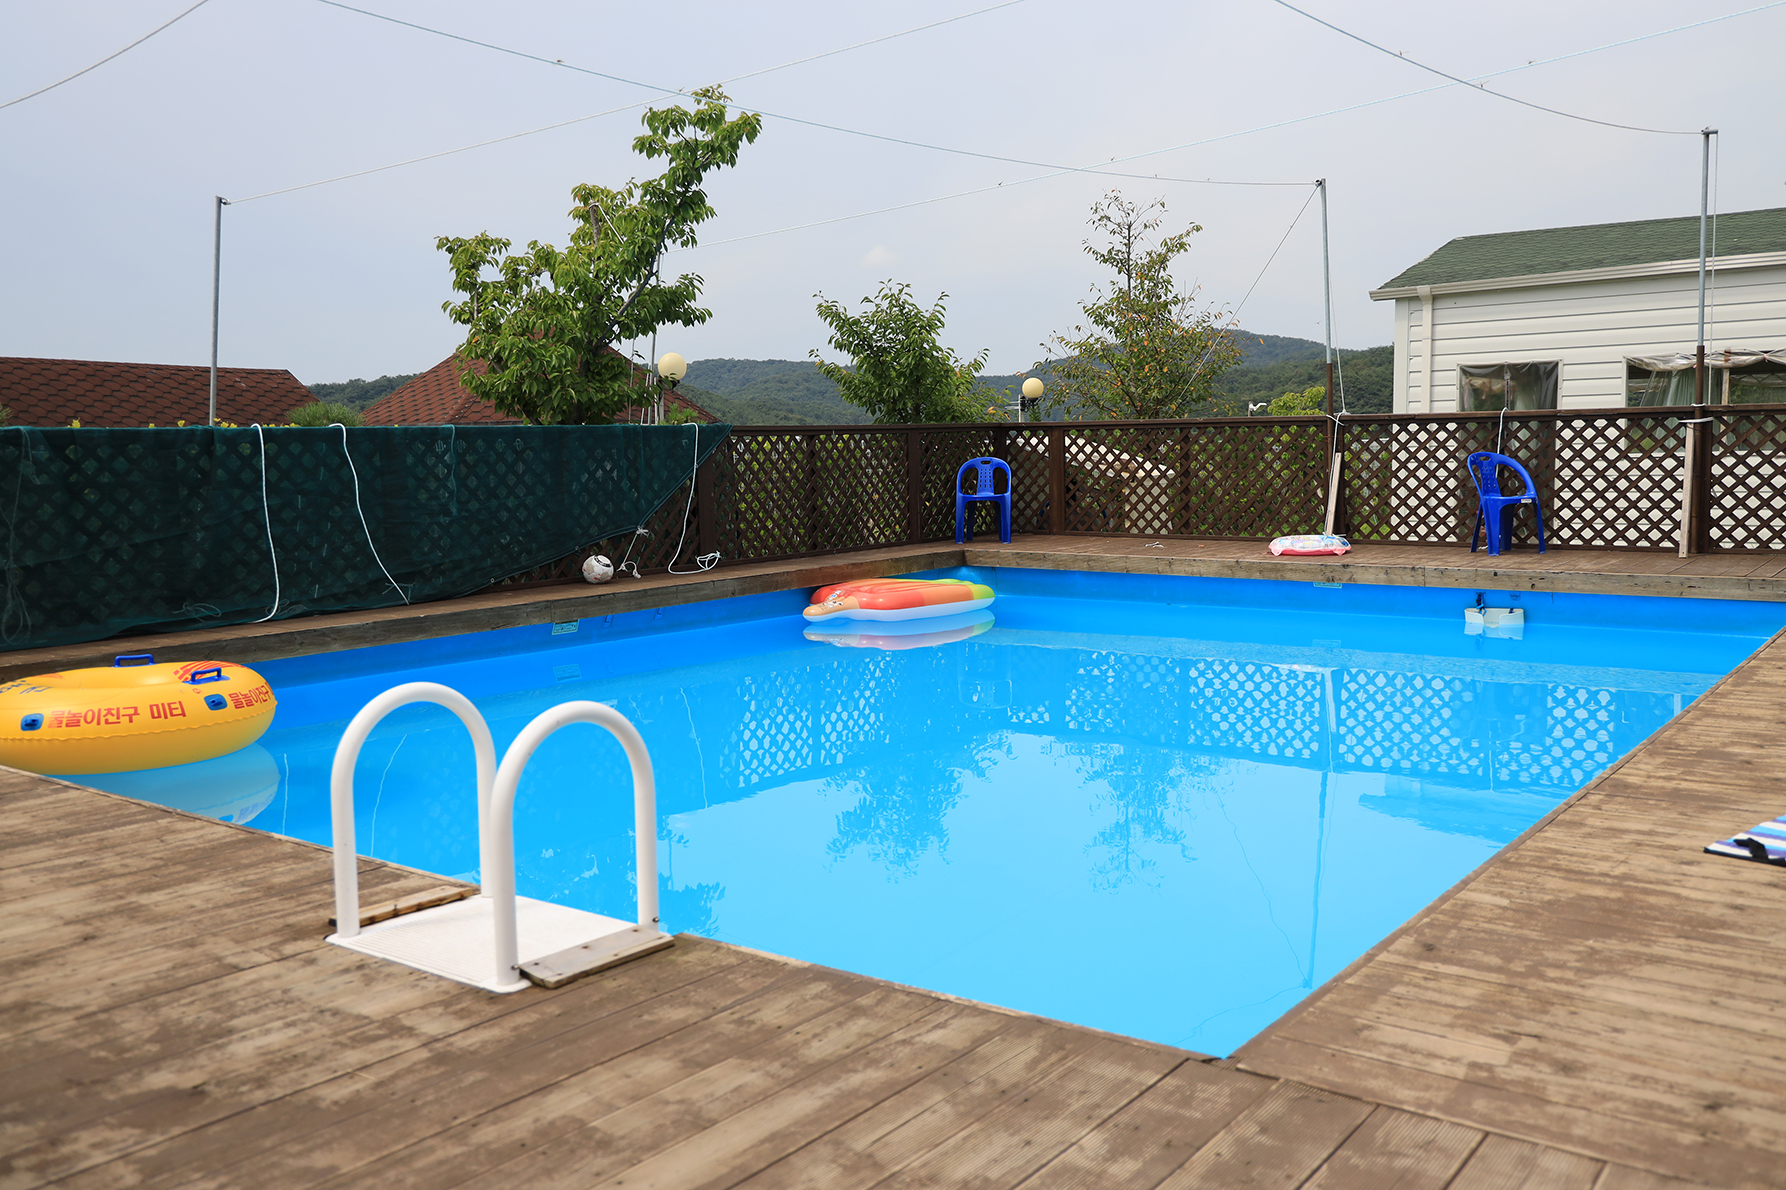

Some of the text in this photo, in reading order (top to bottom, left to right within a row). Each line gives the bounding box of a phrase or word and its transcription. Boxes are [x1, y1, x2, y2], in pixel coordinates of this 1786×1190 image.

[228, 685, 271, 709] 물놀이친구
[47, 701, 187, 728] 물놀이친구 미티
